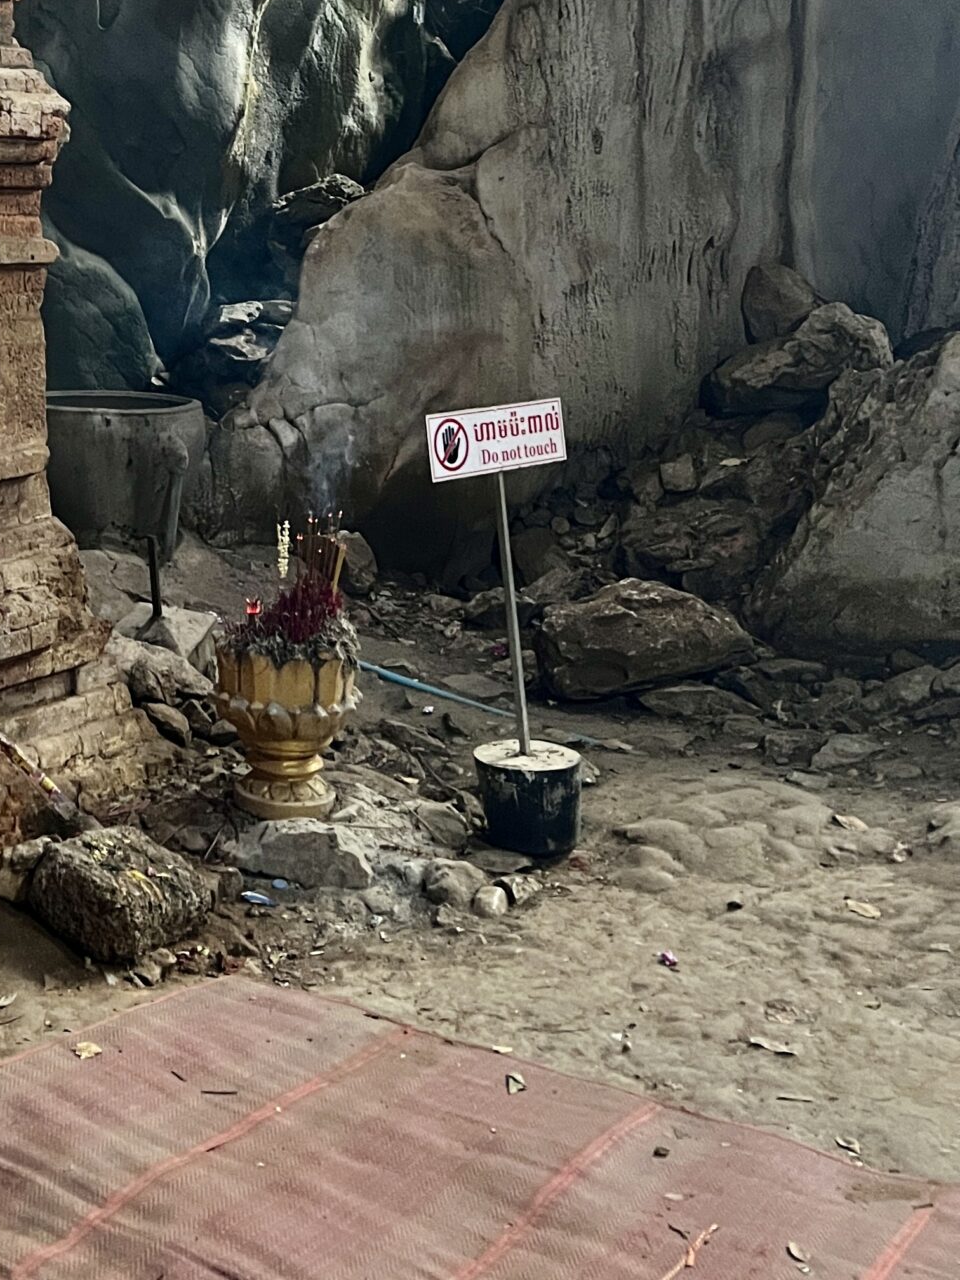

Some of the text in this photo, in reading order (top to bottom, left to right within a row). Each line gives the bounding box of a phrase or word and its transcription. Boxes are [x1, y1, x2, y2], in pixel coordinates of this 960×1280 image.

[481, 437, 558, 465] Do not touch
